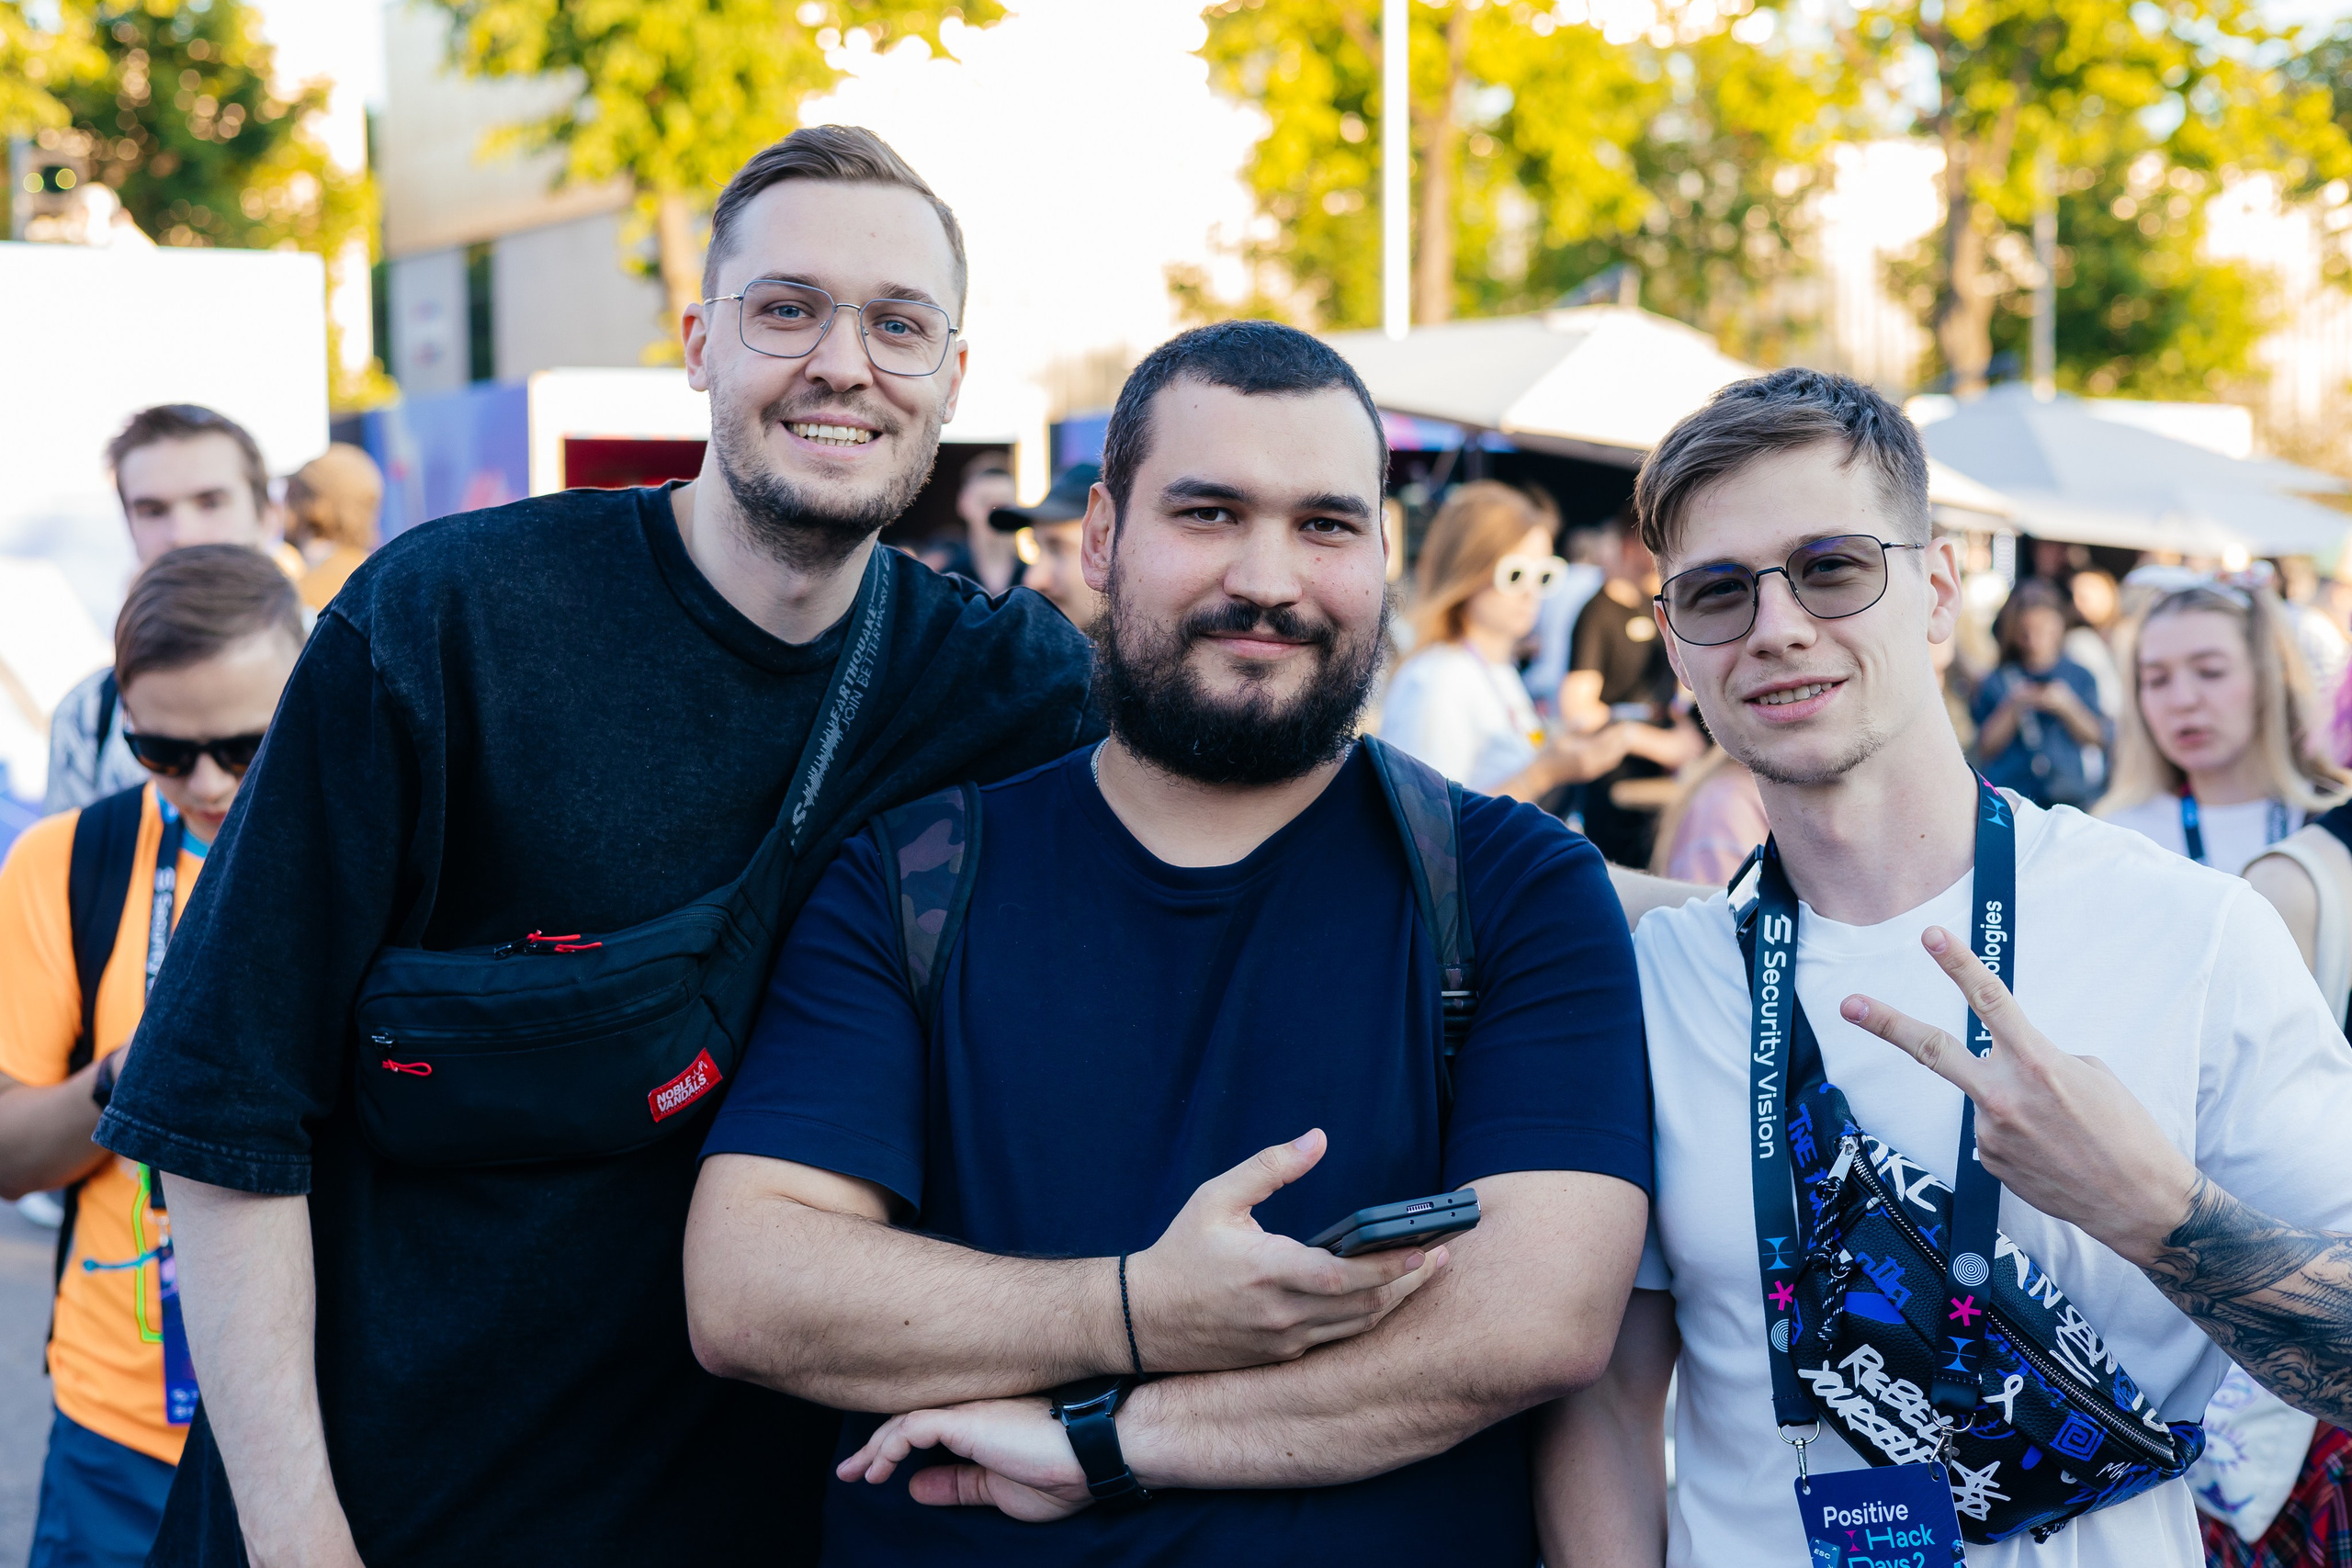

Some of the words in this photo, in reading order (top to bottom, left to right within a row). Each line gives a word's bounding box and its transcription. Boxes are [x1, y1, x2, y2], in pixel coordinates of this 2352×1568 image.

[831, 602, 877, 722] EARTHQUAKE
[842, 689, 864, 731] JOIN
[1754, 951, 1787, 1066] Security
[657, 1075, 692, 1104] NOBLE
[658, 1073, 707, 1112] VANDALS
[1758, 1071, 1779, 1159] Vision
[1823, 1500, 1909, 1529] Positive
[1814, 1548, 1831, 1560] ESC
[1865, 1523, 1936, 1551] Hack
[1913, 1551, 1925, 1568] 2
